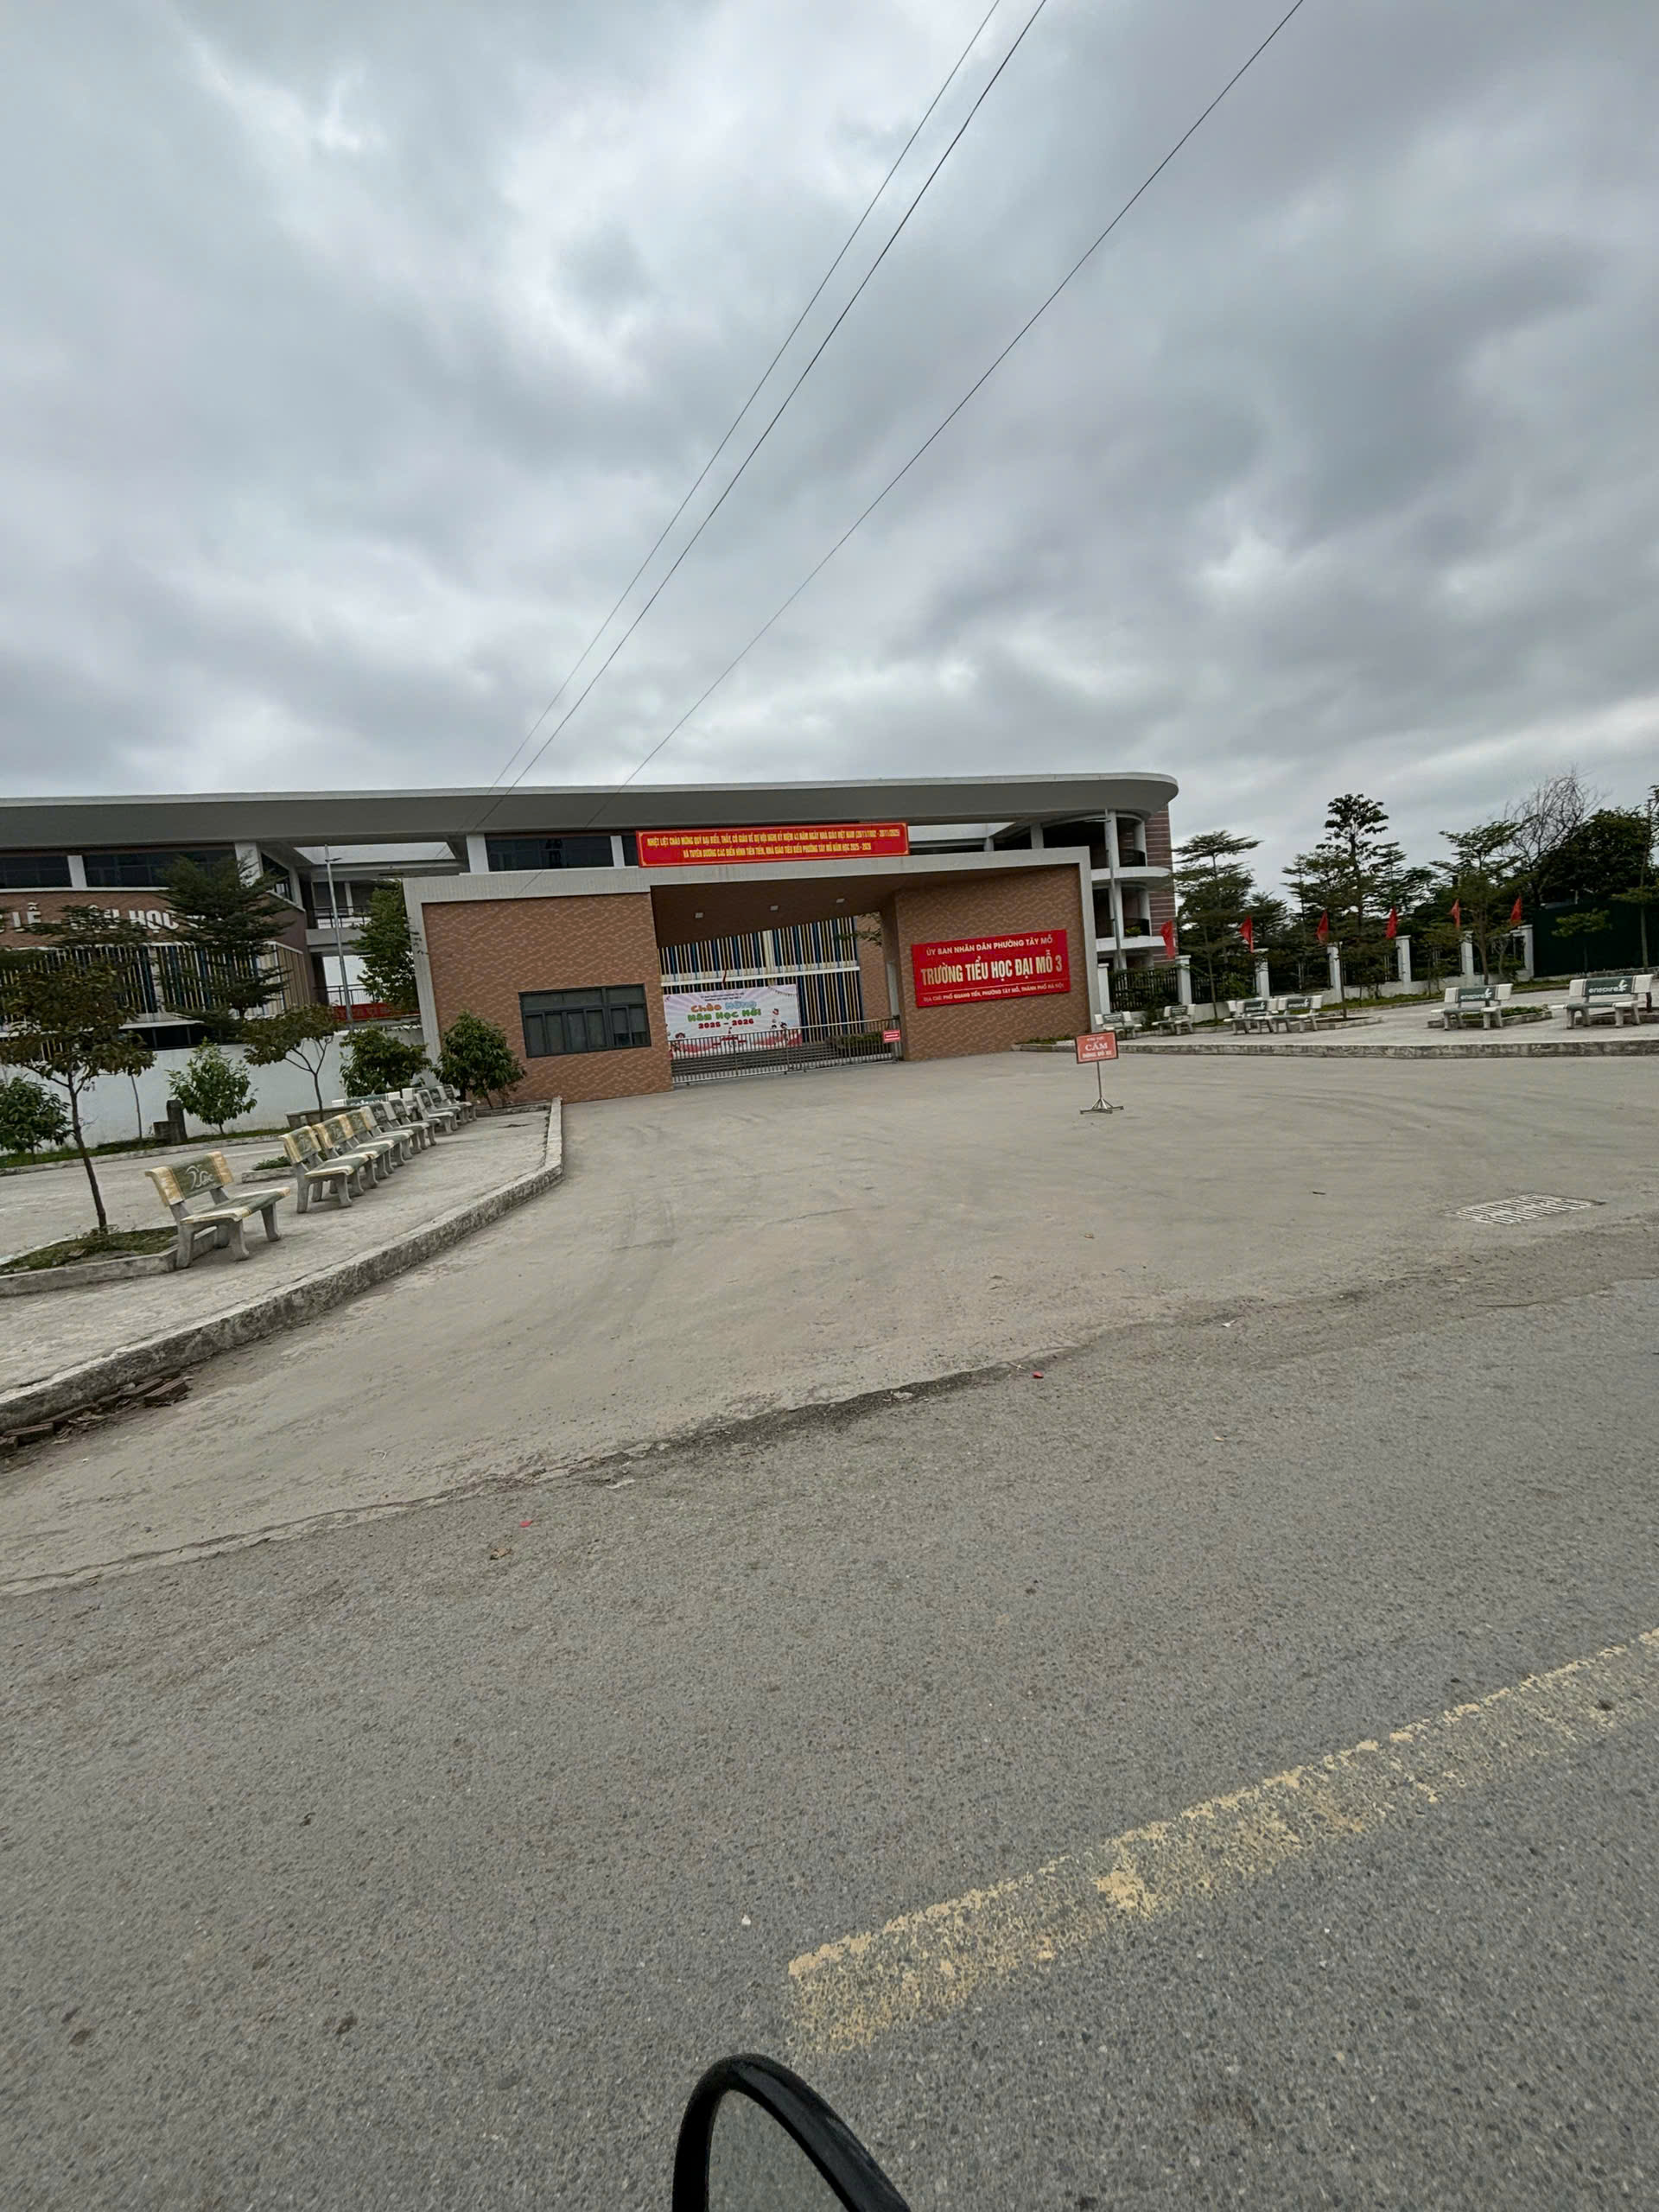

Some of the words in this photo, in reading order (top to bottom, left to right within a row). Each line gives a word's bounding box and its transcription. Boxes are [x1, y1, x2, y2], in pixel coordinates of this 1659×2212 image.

[954, 944, 975, 953] NHÂN
[976, 942, 992, 951] DÂN
[994, 939, 1024, 950] PHƯỜNG
[1026, 937, 1039, 946] TÂY
[921, 963, 963, 986] TRƯỜNG
[965, 956, 988, 982] TIỂU
[991, 959, 1013, 982] HỌC
[1014, 957, 1033, 979] ĐẠI
[1035, 950, 1053, 974] MỖ
[1055, 955, 1063, 972] 3
[691, 1002, 722, 1013] Chào
[715, 1010, 739, 1020] Học
[1085, 1040, 1108, 1052] CẤM
